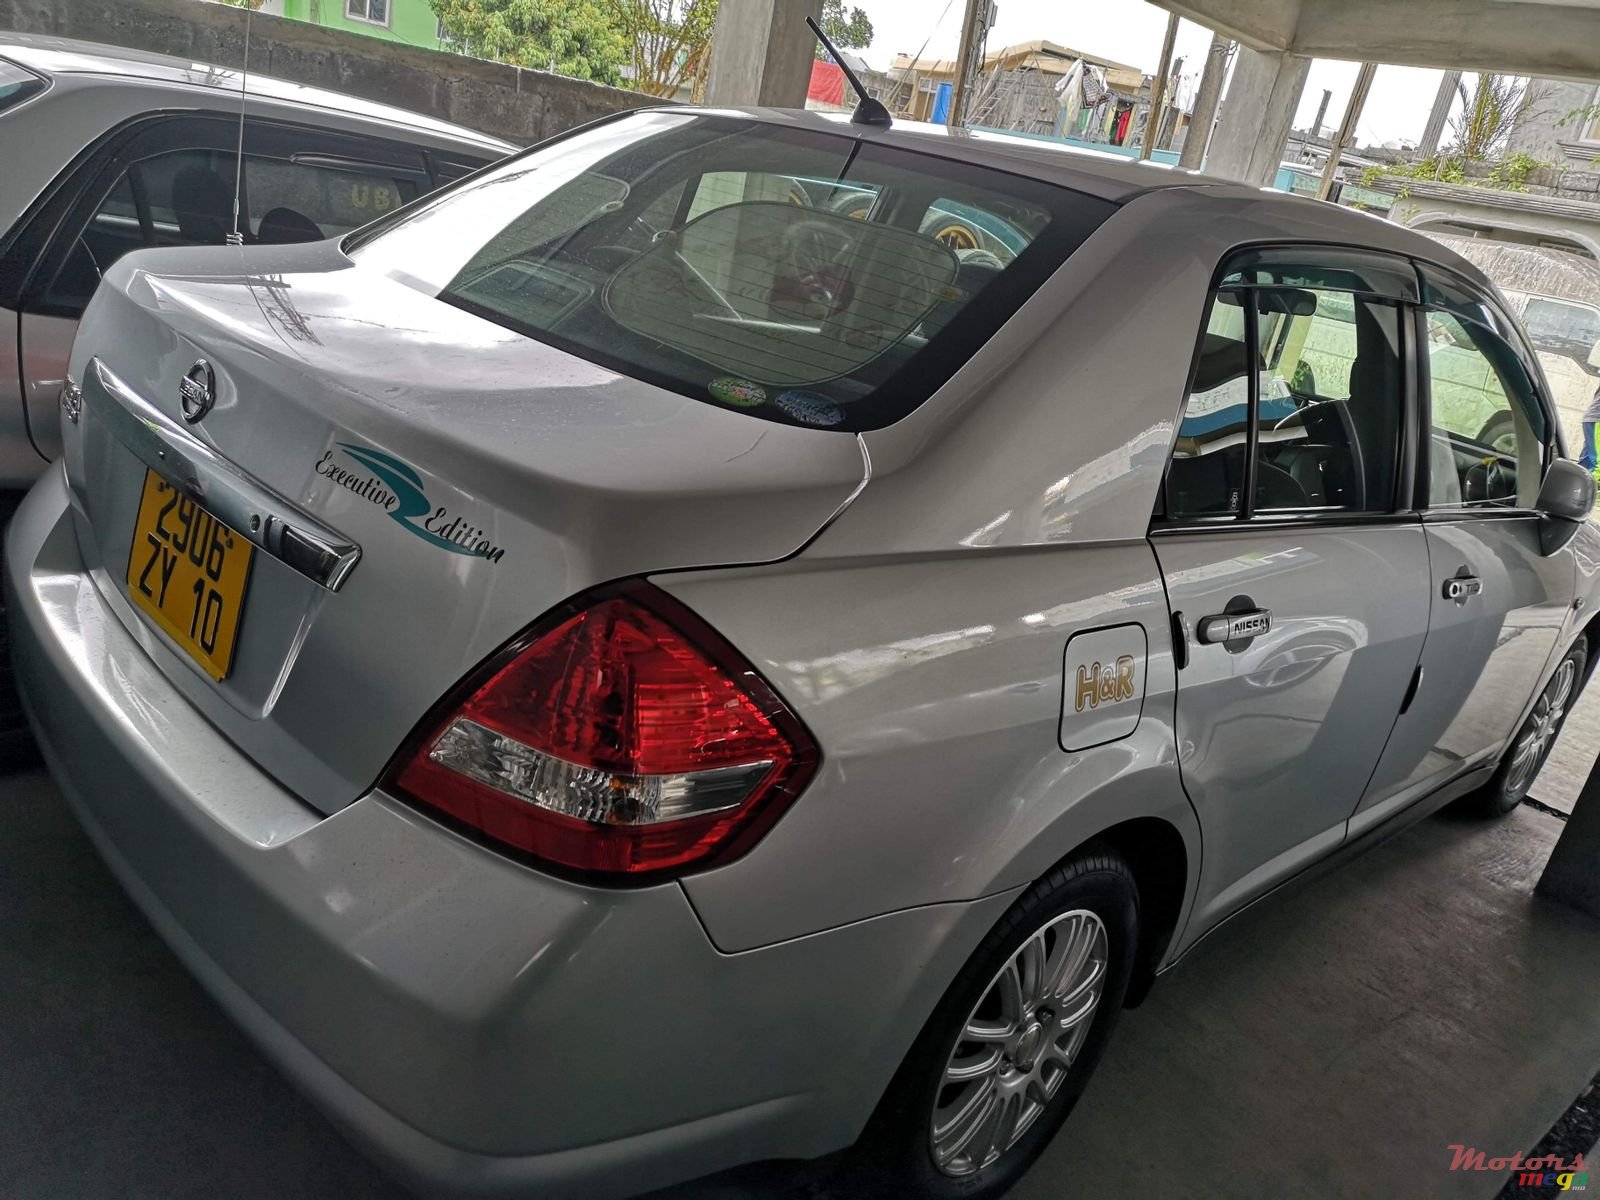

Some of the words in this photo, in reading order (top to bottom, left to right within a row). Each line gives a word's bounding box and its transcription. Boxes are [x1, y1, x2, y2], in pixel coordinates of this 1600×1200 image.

[156, 485, 229, 582] 2906
[315, 450, 396, 510] Executive
[425, 507, 505, 564] Edition
[139, 532, 178, 608] ZY
[189, 577, 223, 655] 10
[1234, 616, 1271, 634] NISSAN
[1074, 654, 1135, 712] H&R
